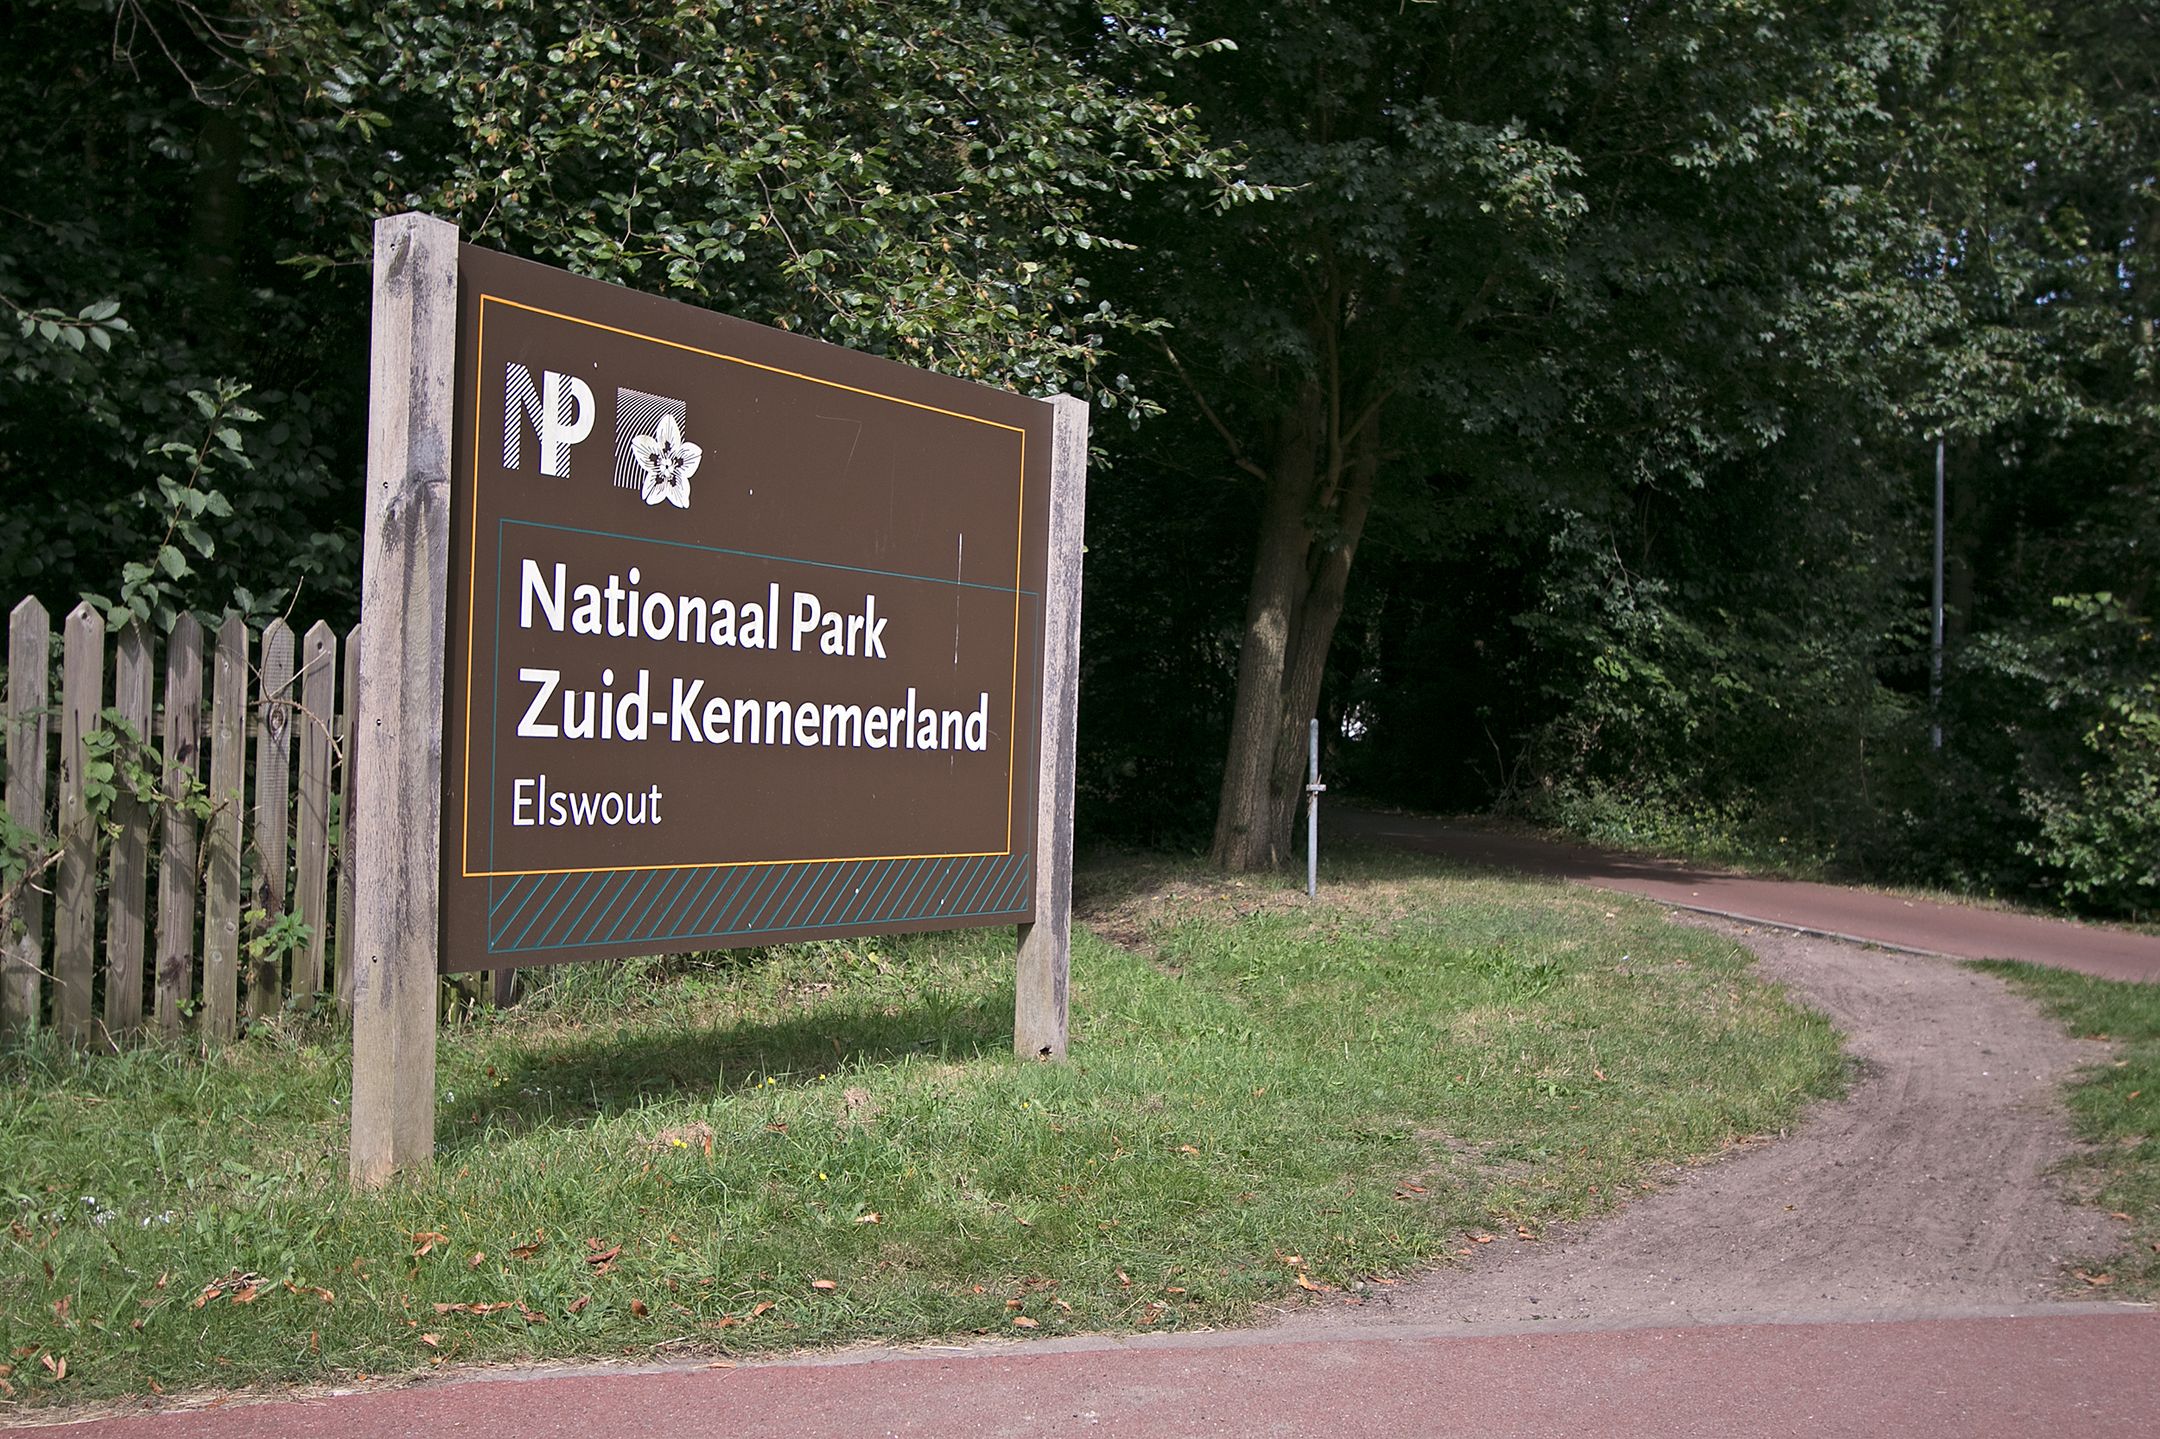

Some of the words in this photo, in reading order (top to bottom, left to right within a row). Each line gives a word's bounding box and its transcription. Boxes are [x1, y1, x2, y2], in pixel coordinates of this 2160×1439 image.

[503, 362, 596, 479] NP
[520, 558, 780, 650] Nationaal
[792, 591, 888, 659] Park
[516, 668, 989, 752] Zuid-Kennemerland
[512, 774, 663, 826] Elswout
